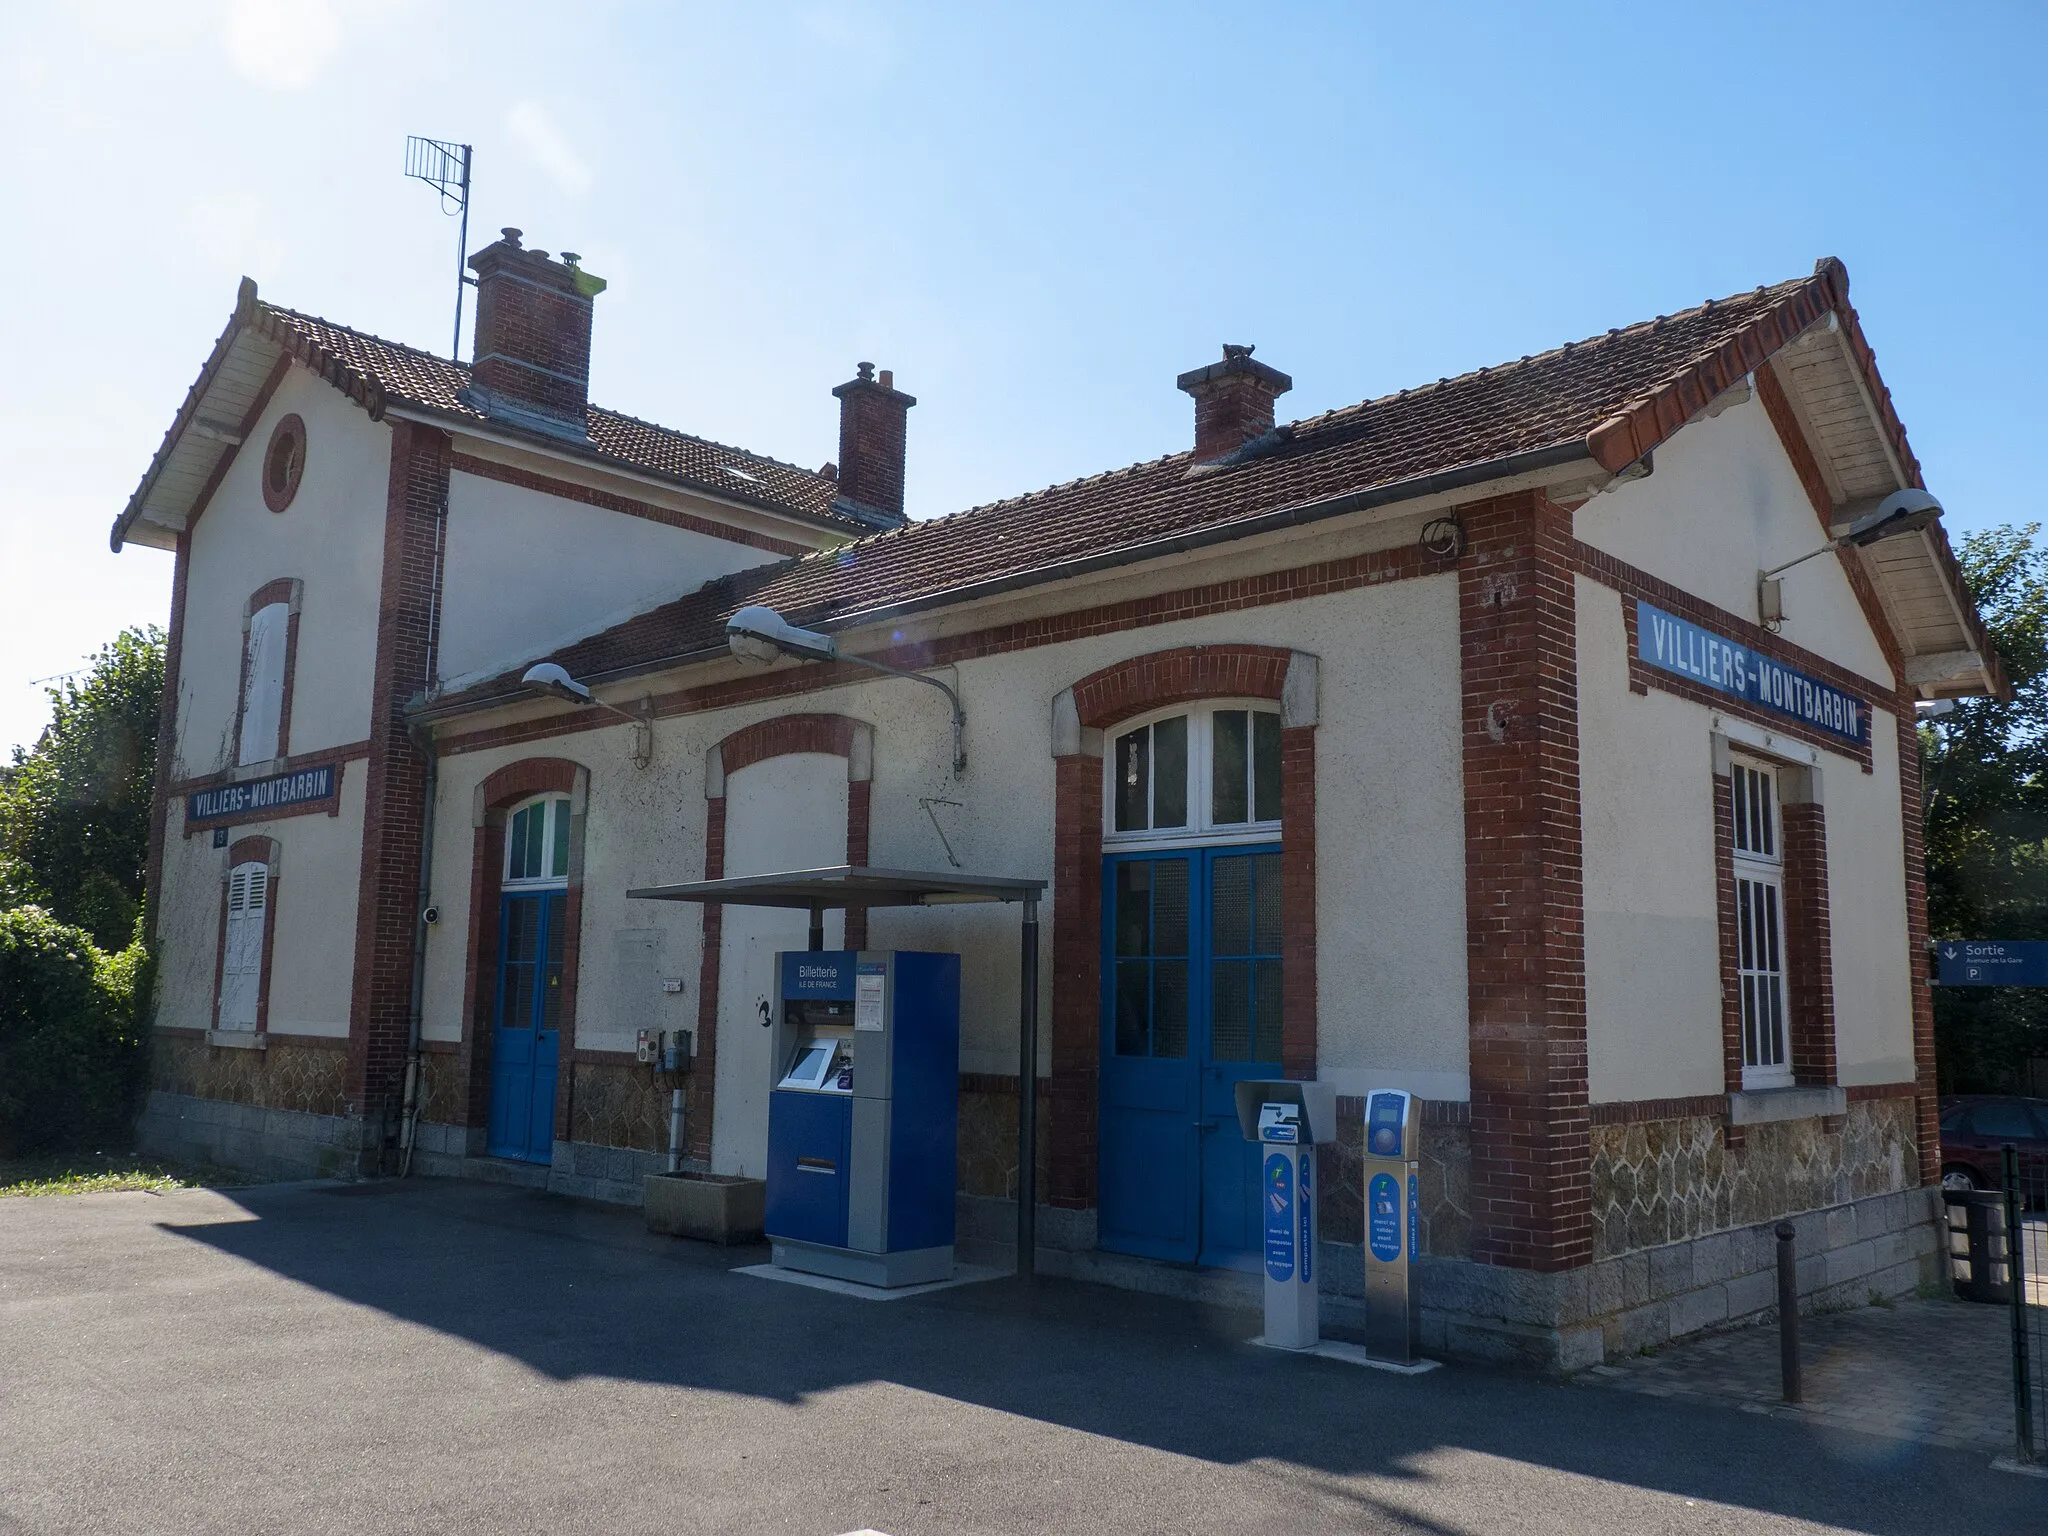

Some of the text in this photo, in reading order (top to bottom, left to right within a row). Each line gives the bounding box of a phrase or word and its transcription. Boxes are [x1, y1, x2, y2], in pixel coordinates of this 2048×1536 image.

[1652, 614, 1858, 737] VILLIERS-MONTBARBIN
[197, 769, 328, 817] VILLIERS-MONTBARBIN
[1965, 945, 2005, 956] Sortie
[799, 965, 838, 978] Billetterie
[1969, 969, 1978, 978] P
[807, 980, 815, 988] DE
[815, 980, 838, 988] FRANCE
